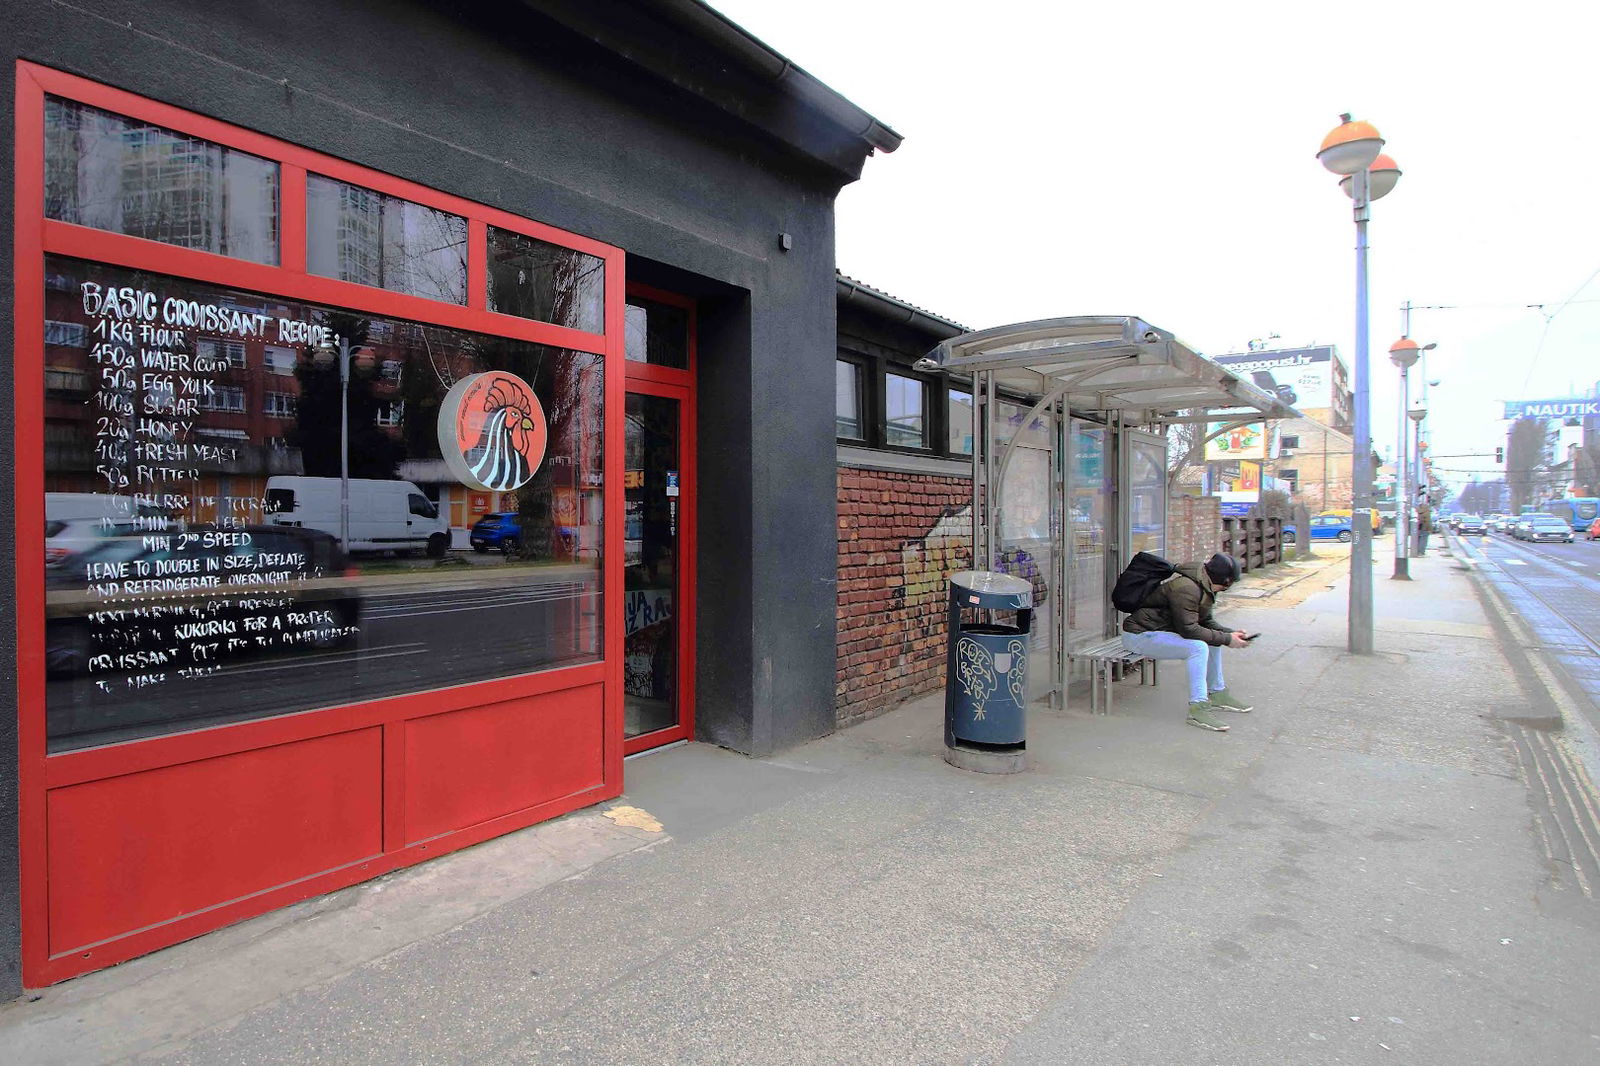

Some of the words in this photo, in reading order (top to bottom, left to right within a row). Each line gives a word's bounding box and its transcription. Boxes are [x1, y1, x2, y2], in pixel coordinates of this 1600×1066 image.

[81, 282, 158, 321] BASIC
[163, 297, 273, 337] CROISSANT
[279, 318, 340, 348] RECIPE:
[139, 324, 187, 348] FLOUR
[141, 348, 192, 372] WATER
[1222, 355, 1312, 373] egapopust.hr
[101, 367, 137, 394] 50g
[142, 373, 174, 395] EGG
[179, 375, 216, 396] YOLK
[143, 394, 201, 417] SUGAR
[1525, 403, 1600, 416] NAUTIK
[96, 417, 130, 443] 20g
[136, 418, 193, 441] HONEY
[135, 440, 188, 461] FRESH
[193, 443, 237, 464] YEAST
[142, 535, 171, 553] MIN
[177, 533, 200, 551] 2ND
[203, 532, 252, 548] SPEED
[86, 561, 130, 581] LEAVE
[133, 560, 150, 577] TO
[155, 558, 201, 577] DOUBLE
[206, 556, 220, 572] IN
[223, 554, 257, 572] SIZE,
[259, 552, 306, 570] DEFLATE
[87, 583, 119, 597] AND
[124, 576, 221, 594] REFRIDGERATE
[228, 570, 292, 586] OVERNIGHT
[243, 616, 268, 632] FOR
[272, 614, 282, 631] A
[287, 610, 335, 627] PROPER
[88, 647, 180, 673] CRISSANT
